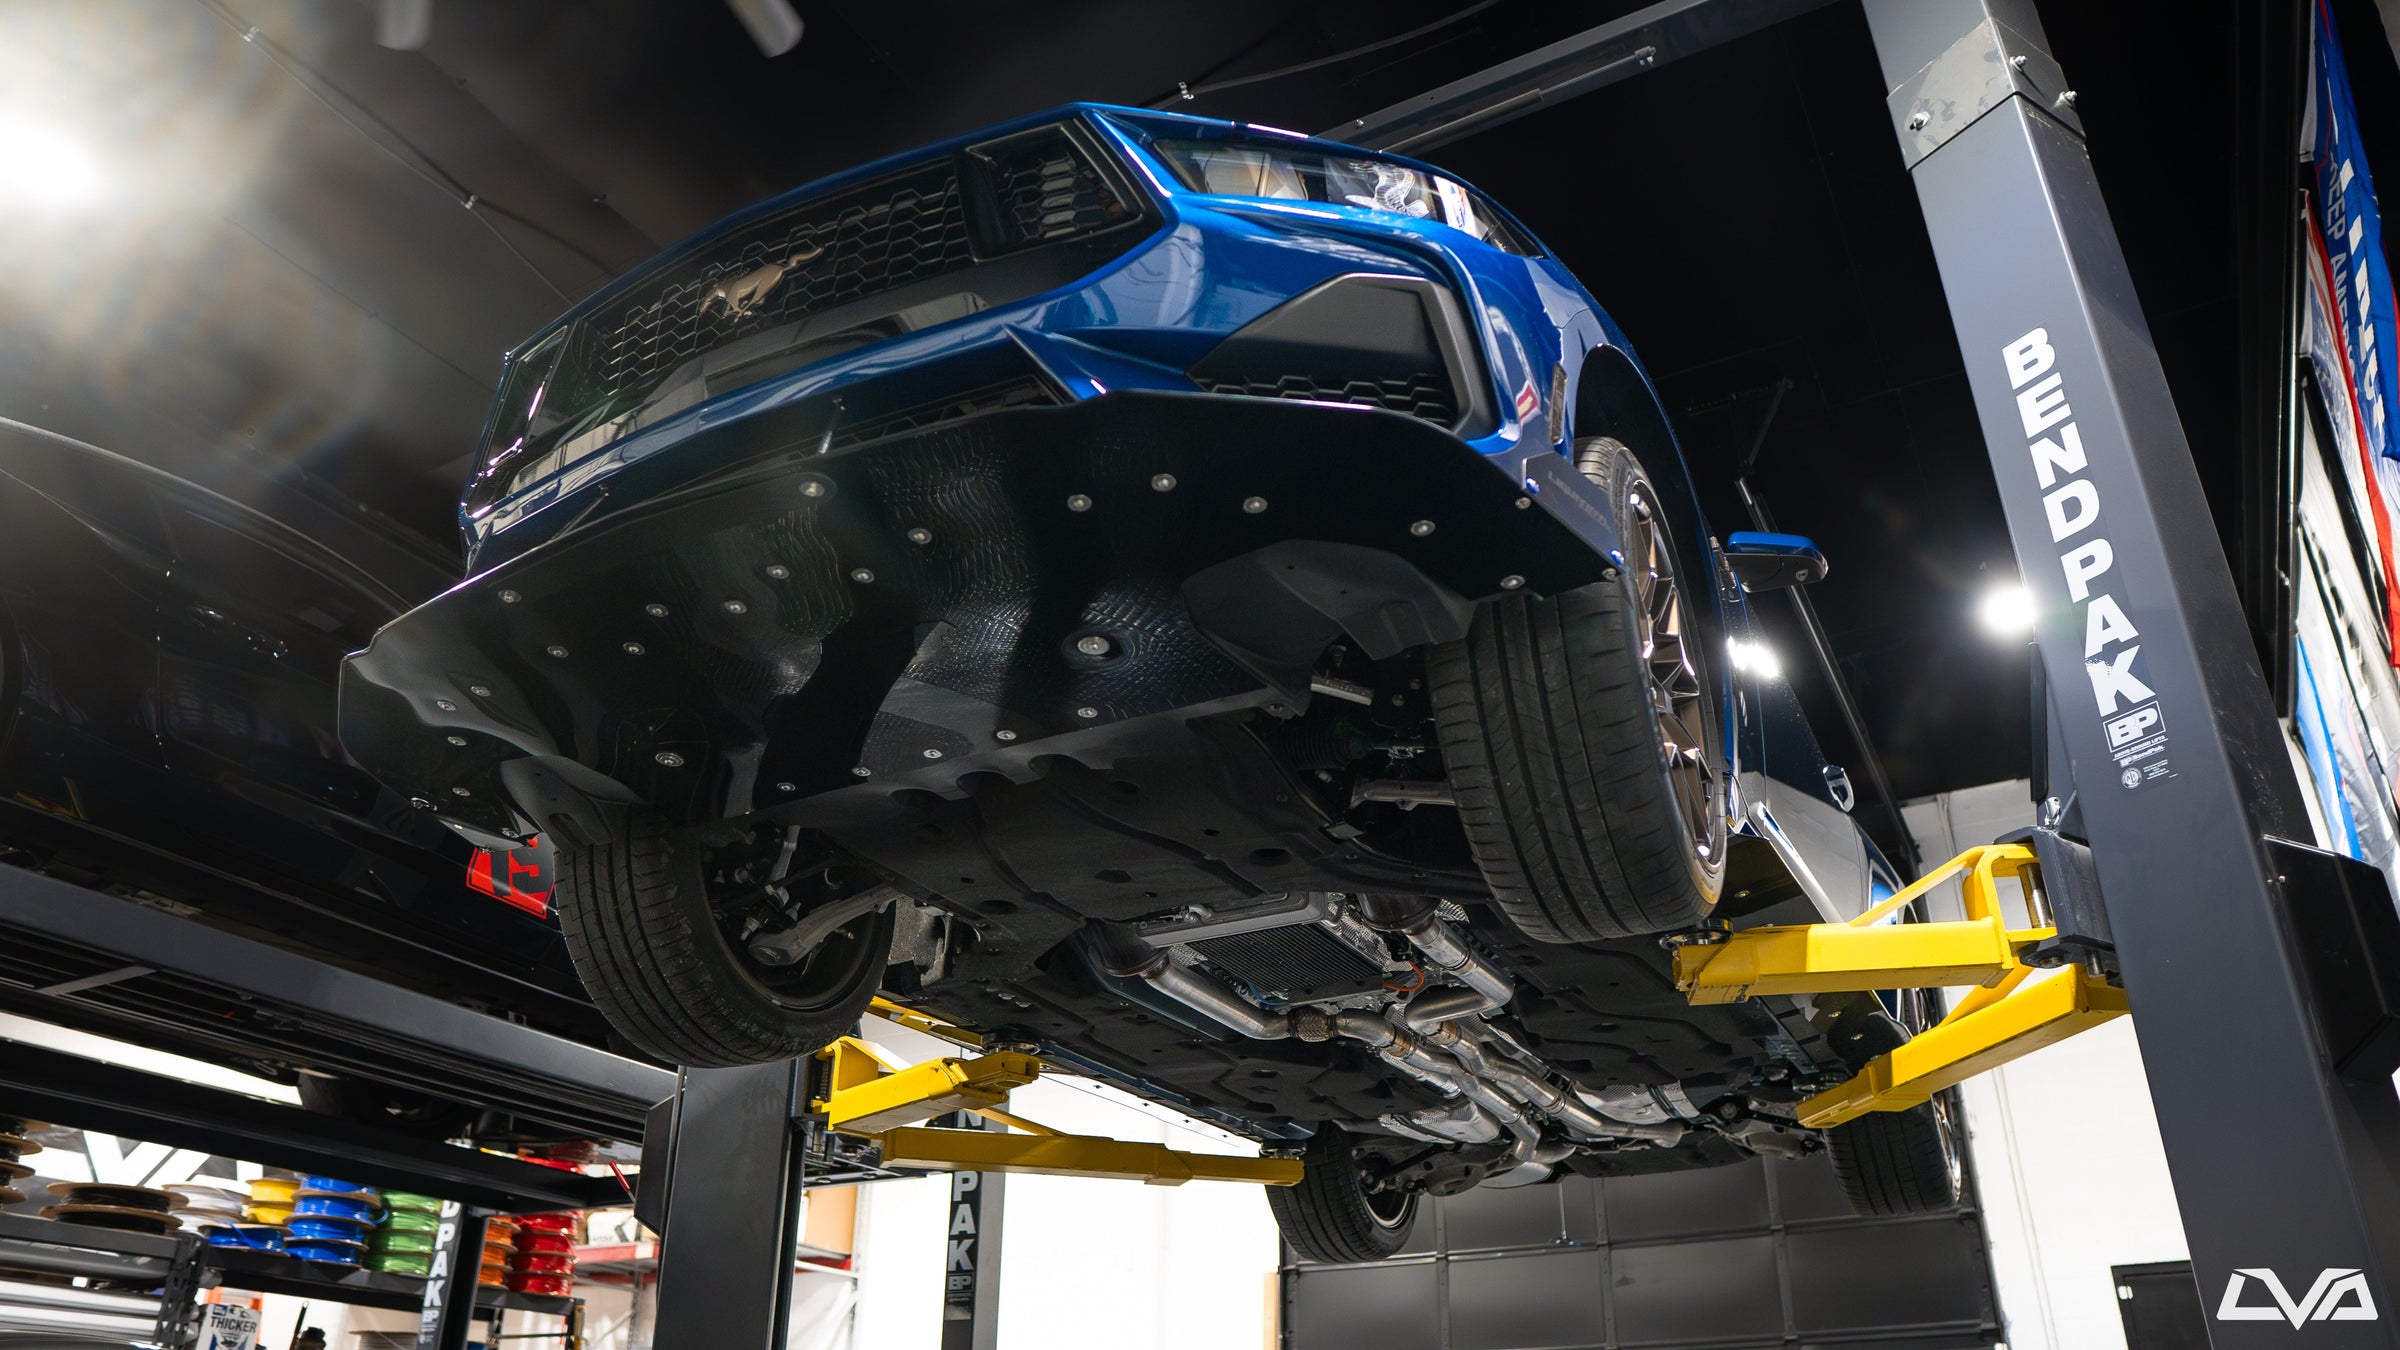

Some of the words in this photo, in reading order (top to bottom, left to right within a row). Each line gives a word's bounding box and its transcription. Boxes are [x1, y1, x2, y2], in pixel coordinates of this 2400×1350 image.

[2001, 327, 2157, 718] BENDPAK
[2108, 707, 2158, 748] BP
[210, 1316, 258, 1334] THICKER
